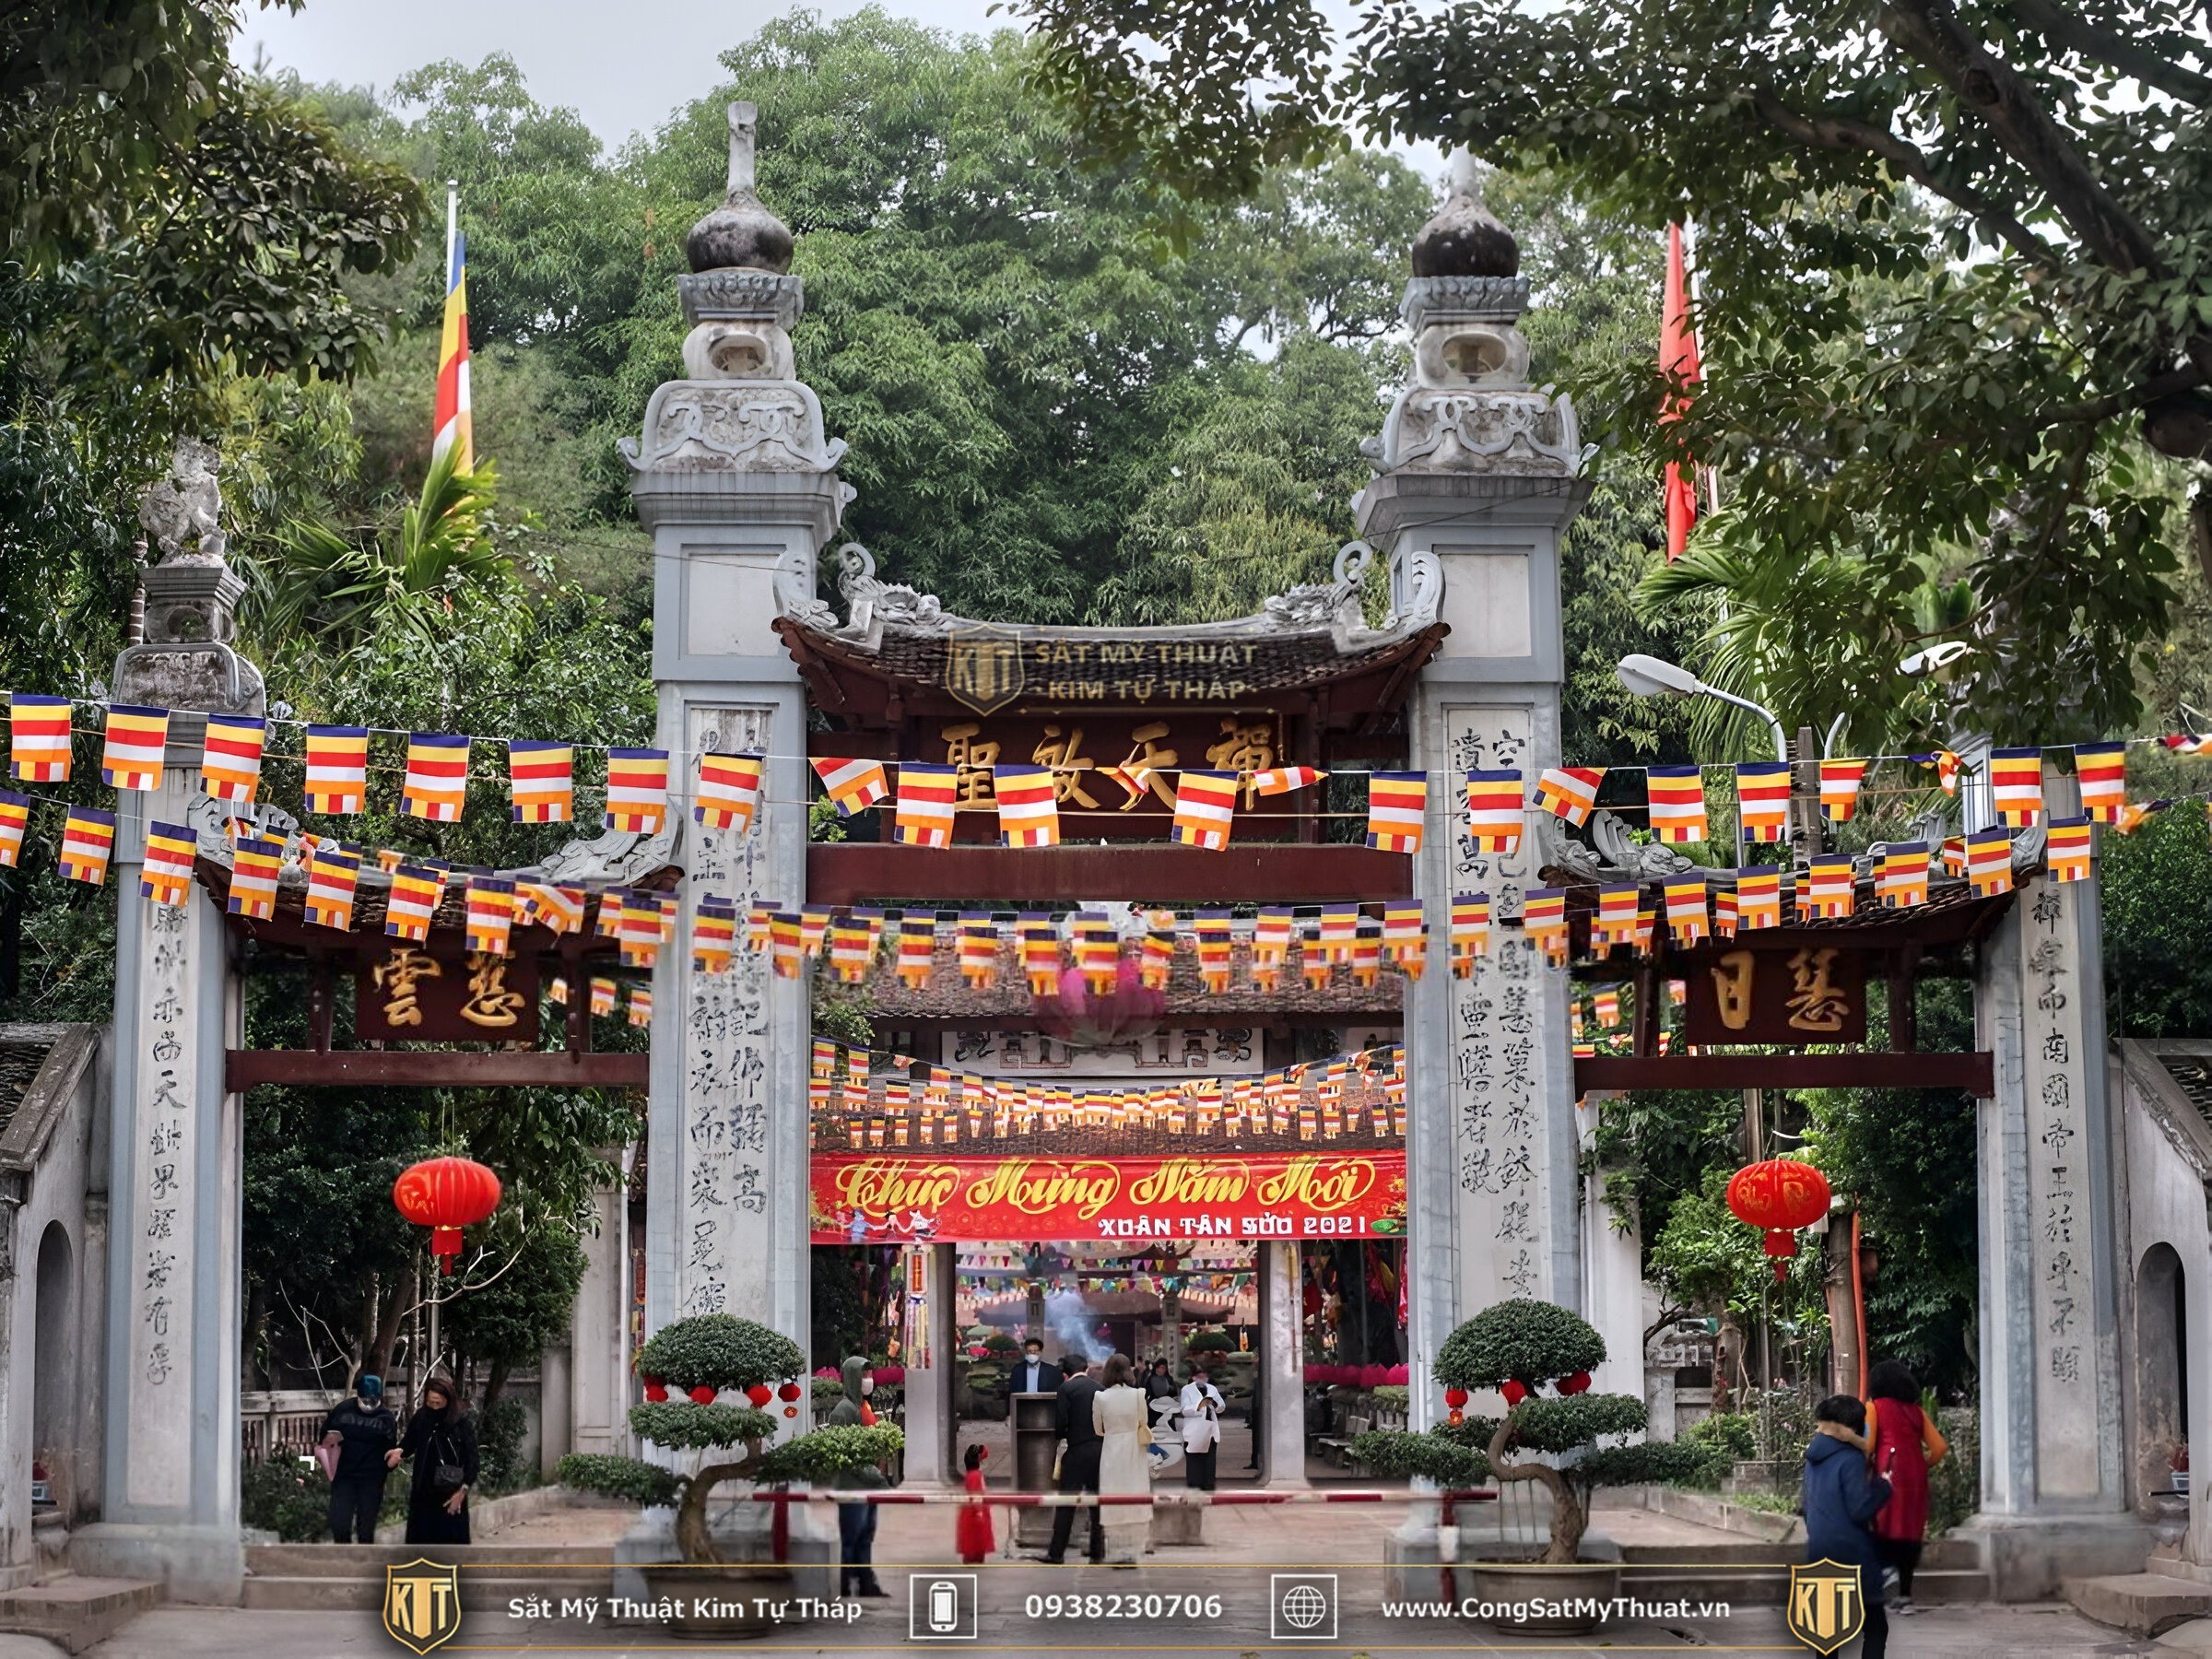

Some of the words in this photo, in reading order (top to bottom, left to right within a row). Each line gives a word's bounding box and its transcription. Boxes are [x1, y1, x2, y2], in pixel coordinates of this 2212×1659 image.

[835, 1157, 961, 1218] Chúc
[965, 1157, 1122, 1220] Mừng
[1129, 1157, 1251, 1205] Năm
[1256, 1155, 1376, 1212] Mới
[1098, 1216, 1171, 1236] XUÂN
[1179, 1215, 1232, 1236] TÂN
[1241, 1212, 1292, 1235] SỬU
[1303, 1216, 1366, 1234] 2021
